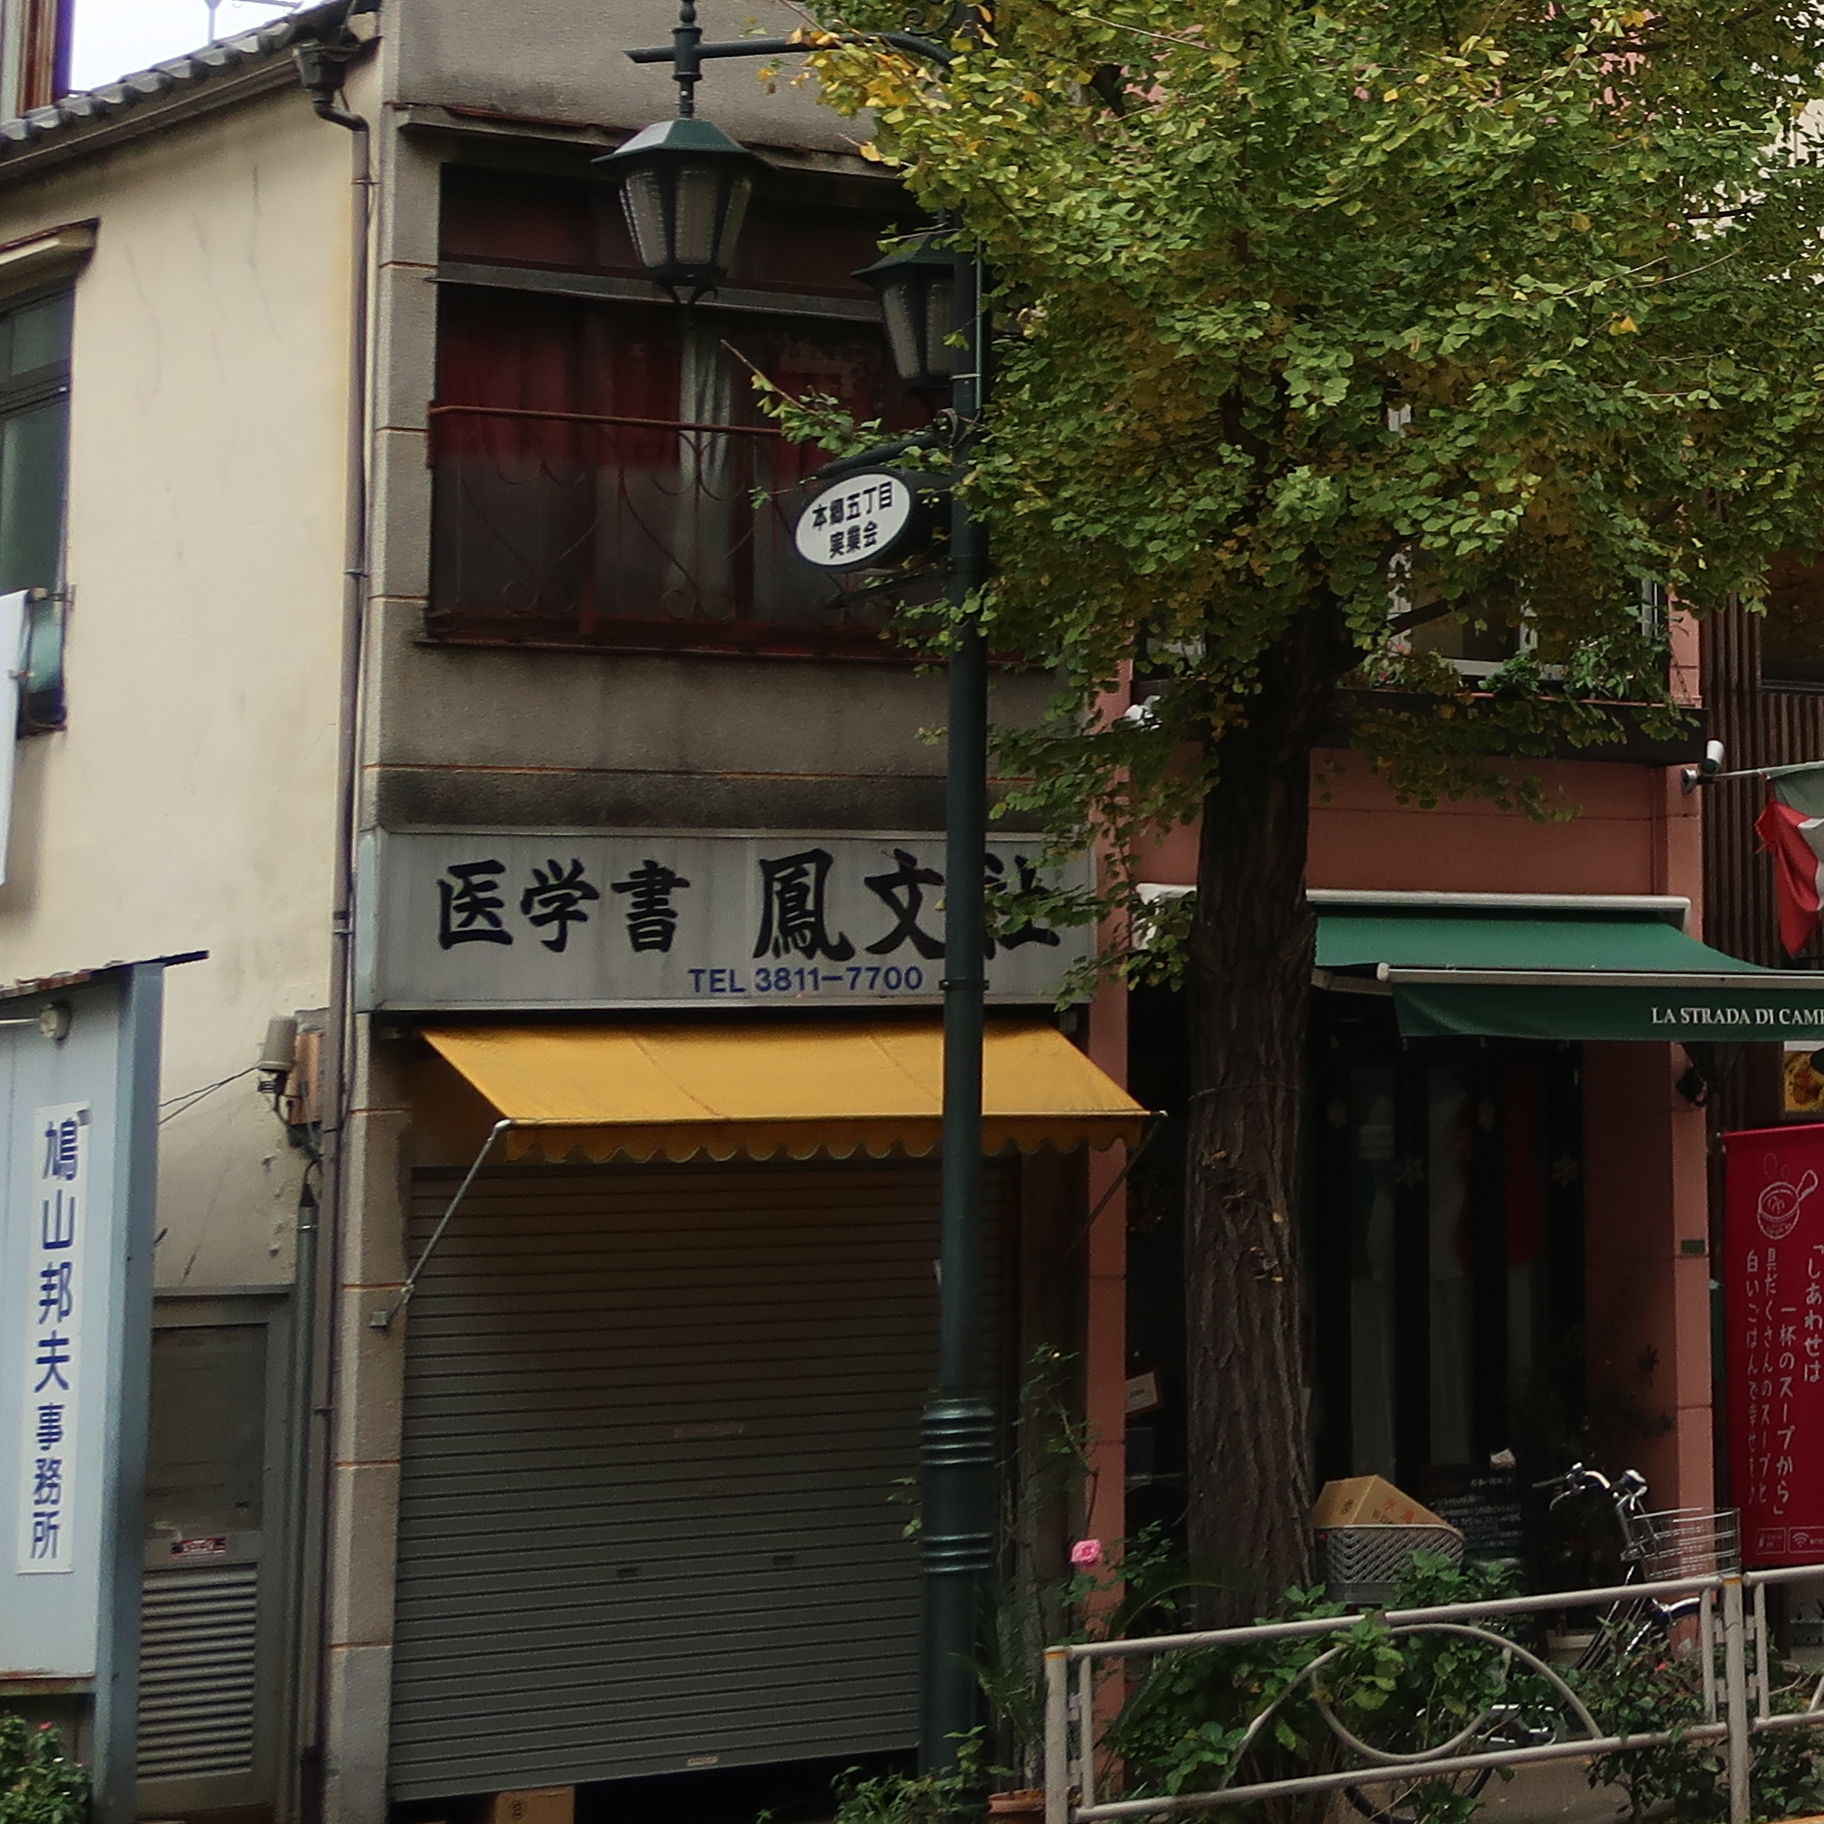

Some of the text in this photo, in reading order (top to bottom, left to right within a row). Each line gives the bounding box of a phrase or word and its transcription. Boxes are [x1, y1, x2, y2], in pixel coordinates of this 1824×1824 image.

[437, 858, 690, 954] 医学書
[688, 965, 924, 994] TEL 3811-7700
[1651, 1006, 1677, 1024] LA
[1680, 1006, 1751, 1025] STRADA
[1755, 1008, 1775, 1025] DI
[30, 1118, 79, 1560] 鳩山邦夫事務所
